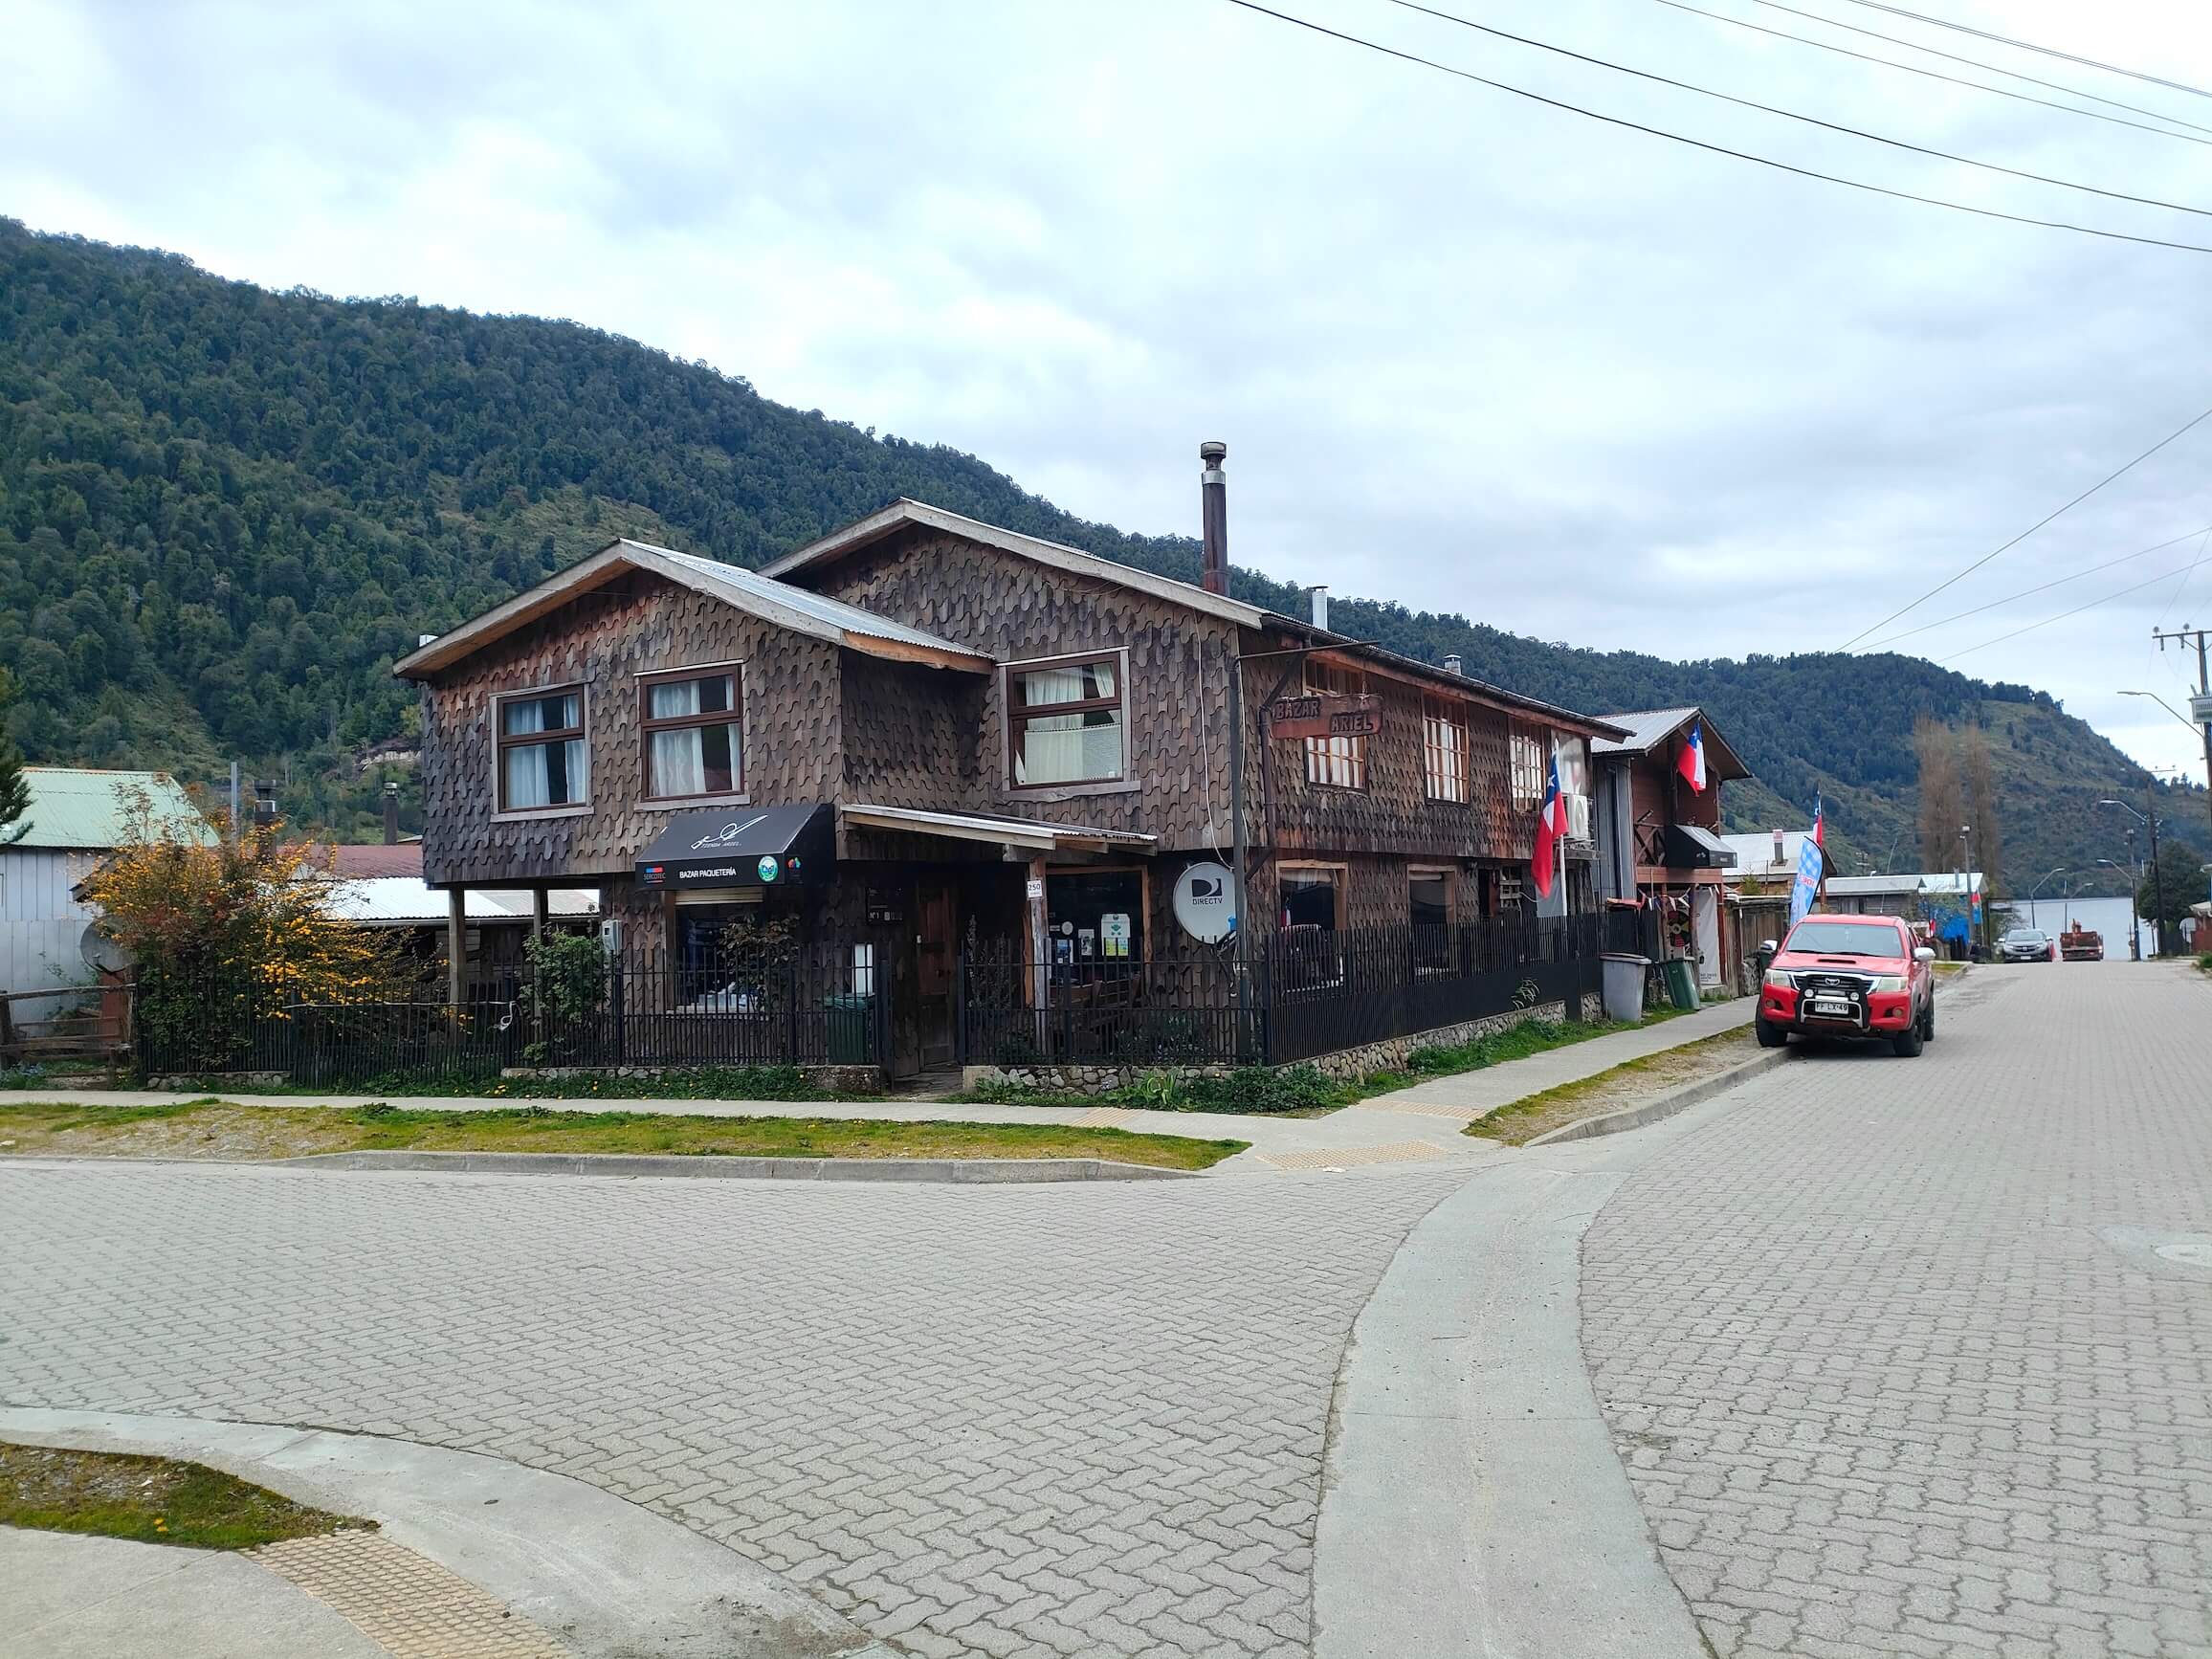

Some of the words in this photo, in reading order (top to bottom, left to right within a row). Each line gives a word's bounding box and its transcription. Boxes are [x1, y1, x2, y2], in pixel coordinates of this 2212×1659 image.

[1275, 699, 1319, 719] BAZAR
[1331, 714, 1373, 733] ARIEL
[679, 870, 698, 879] BAZAR
[699, 867, 737, 877] PAQUETERÍA
[1192, 896, 1224, 905] DIRECTV
